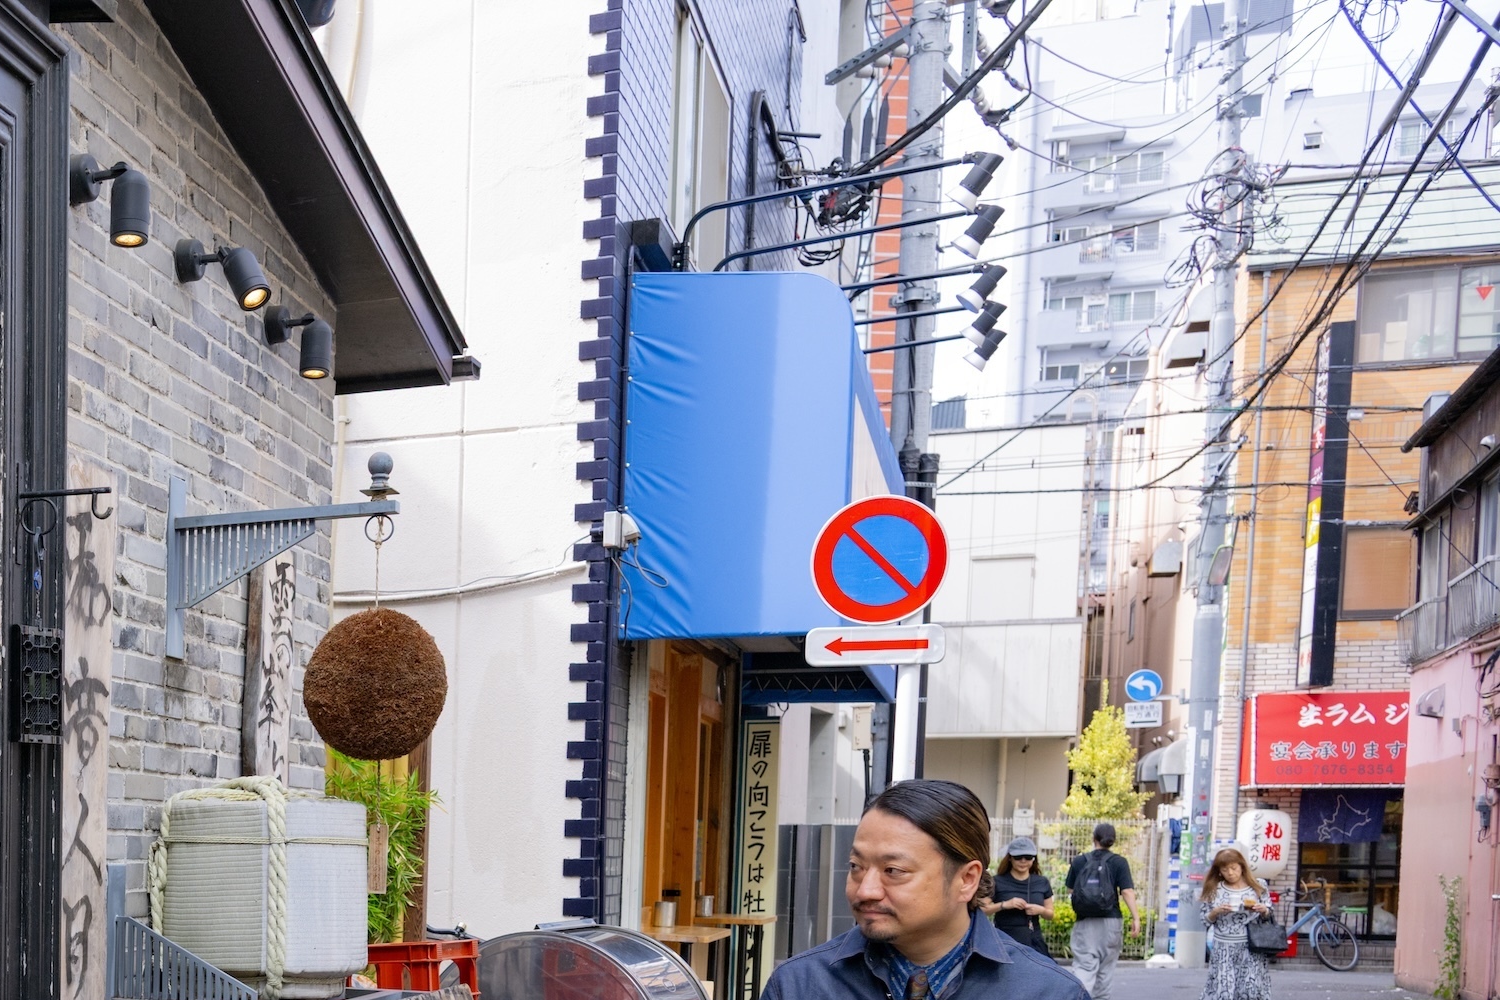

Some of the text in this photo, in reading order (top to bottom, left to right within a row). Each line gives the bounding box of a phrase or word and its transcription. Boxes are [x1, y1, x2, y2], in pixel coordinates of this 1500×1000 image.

[1270, 740, 1407, 761] 宴会承ります
[1275, 764, 1394, 776] 080-7676-8354
[743, 729, 773, 940] 扉の向こうは牡
[1261, 821, 1283, 861] 札幌
